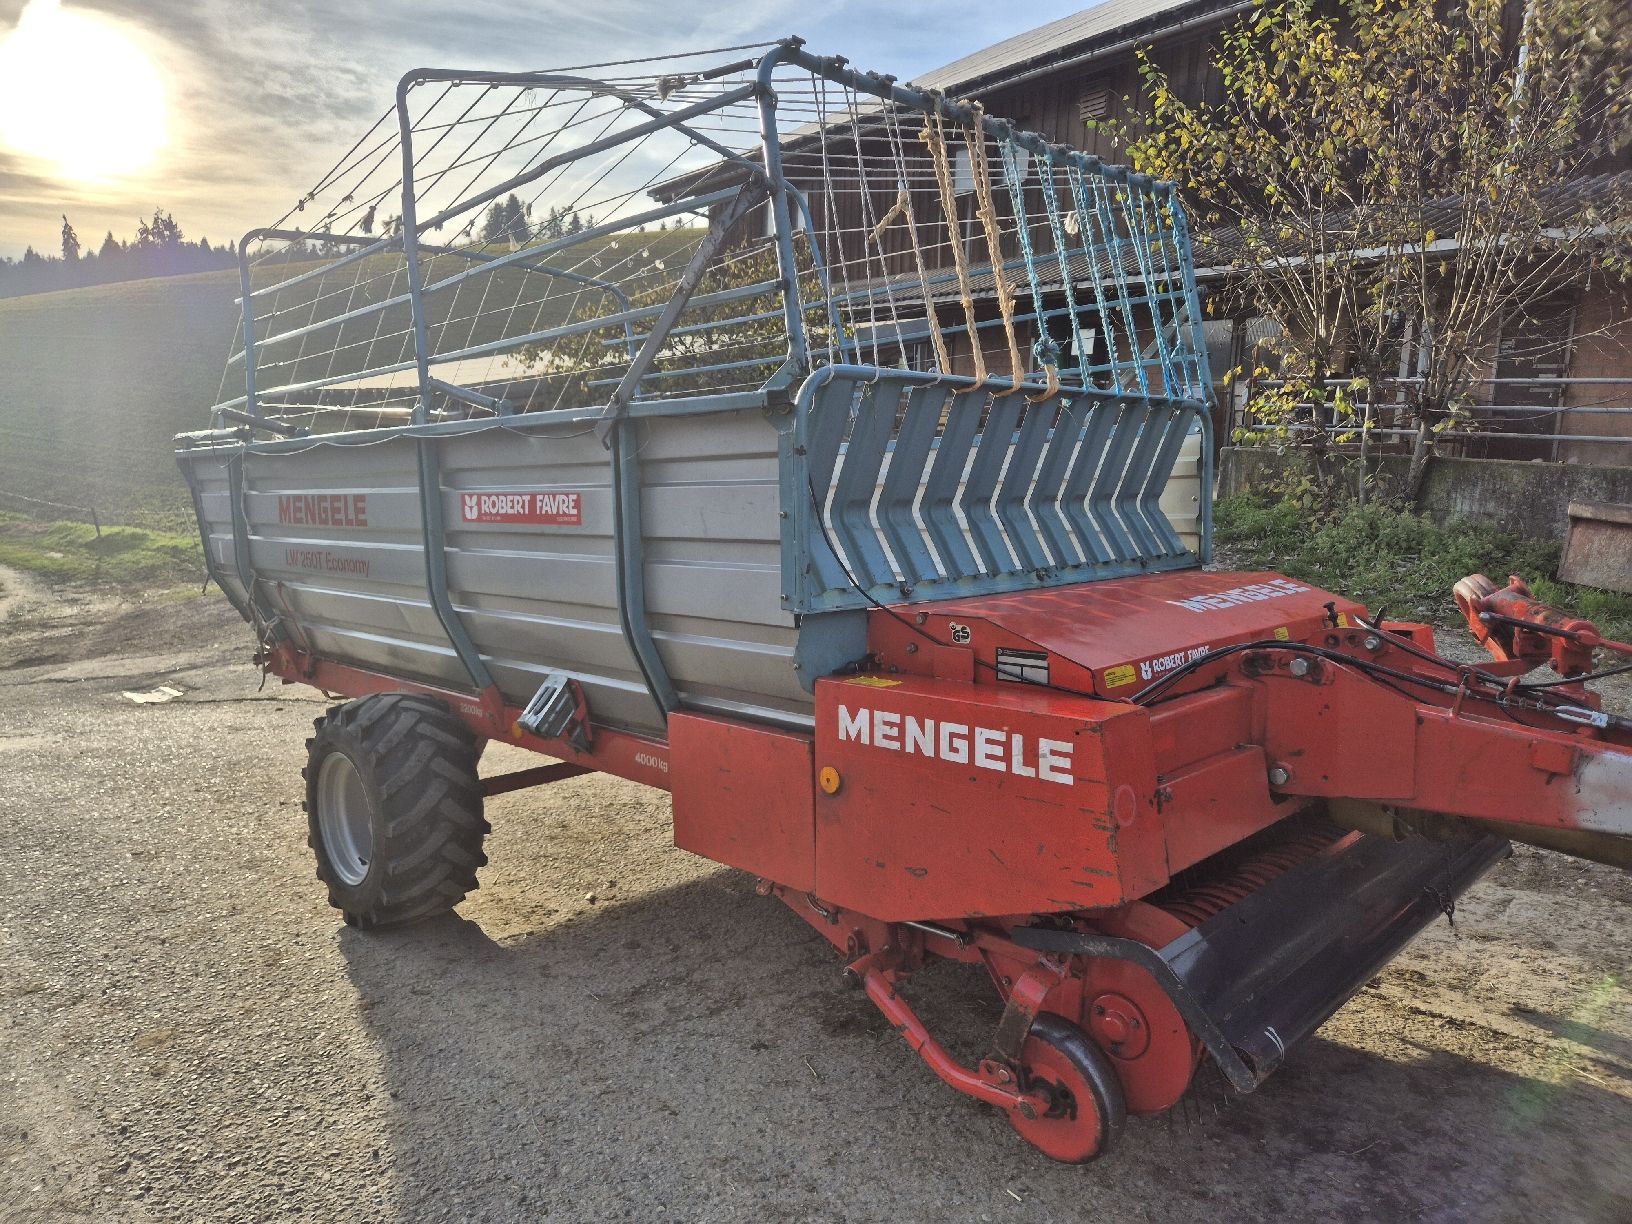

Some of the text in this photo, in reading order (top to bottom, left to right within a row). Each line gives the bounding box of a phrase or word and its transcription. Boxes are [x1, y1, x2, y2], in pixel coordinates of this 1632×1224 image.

[278, 493, 369, 528] MENGELE
[481, 494, 578, 515] ROBERT FAVRE
[325, 551, 370, 578] Economy
[1164, 578, 1312, 613] MENGELE
[1152, 651, 1185, 673] ROBERT
[838, 704, 1074, 786] MENGELE
